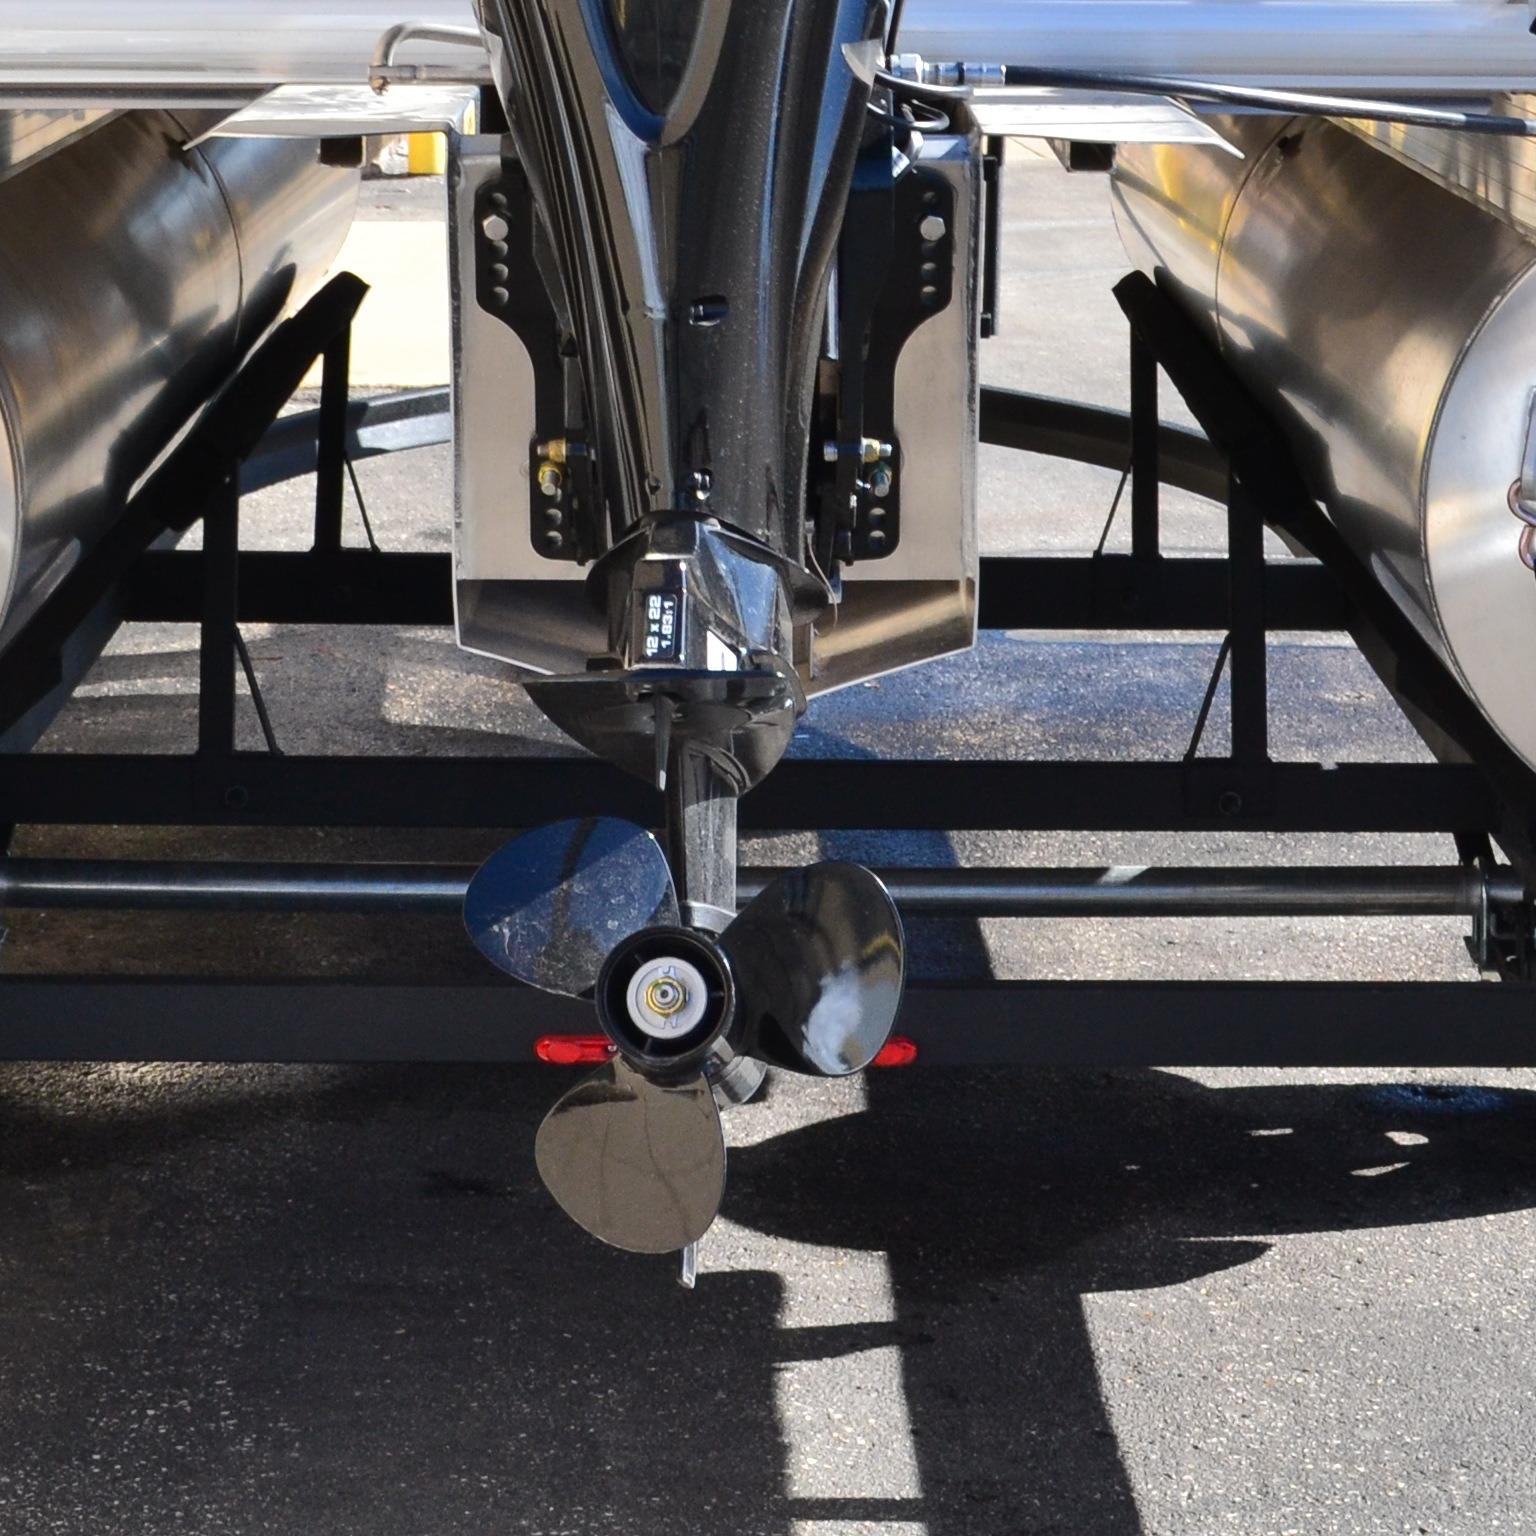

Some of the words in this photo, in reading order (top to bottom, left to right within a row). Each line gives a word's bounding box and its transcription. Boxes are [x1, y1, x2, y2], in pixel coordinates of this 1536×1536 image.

[648, 595, 662, 620] 22
[650, 623, 660, 633] x
[661, 601, 674, 649] 1.83:1
[646, 635, 659, 657] 12
